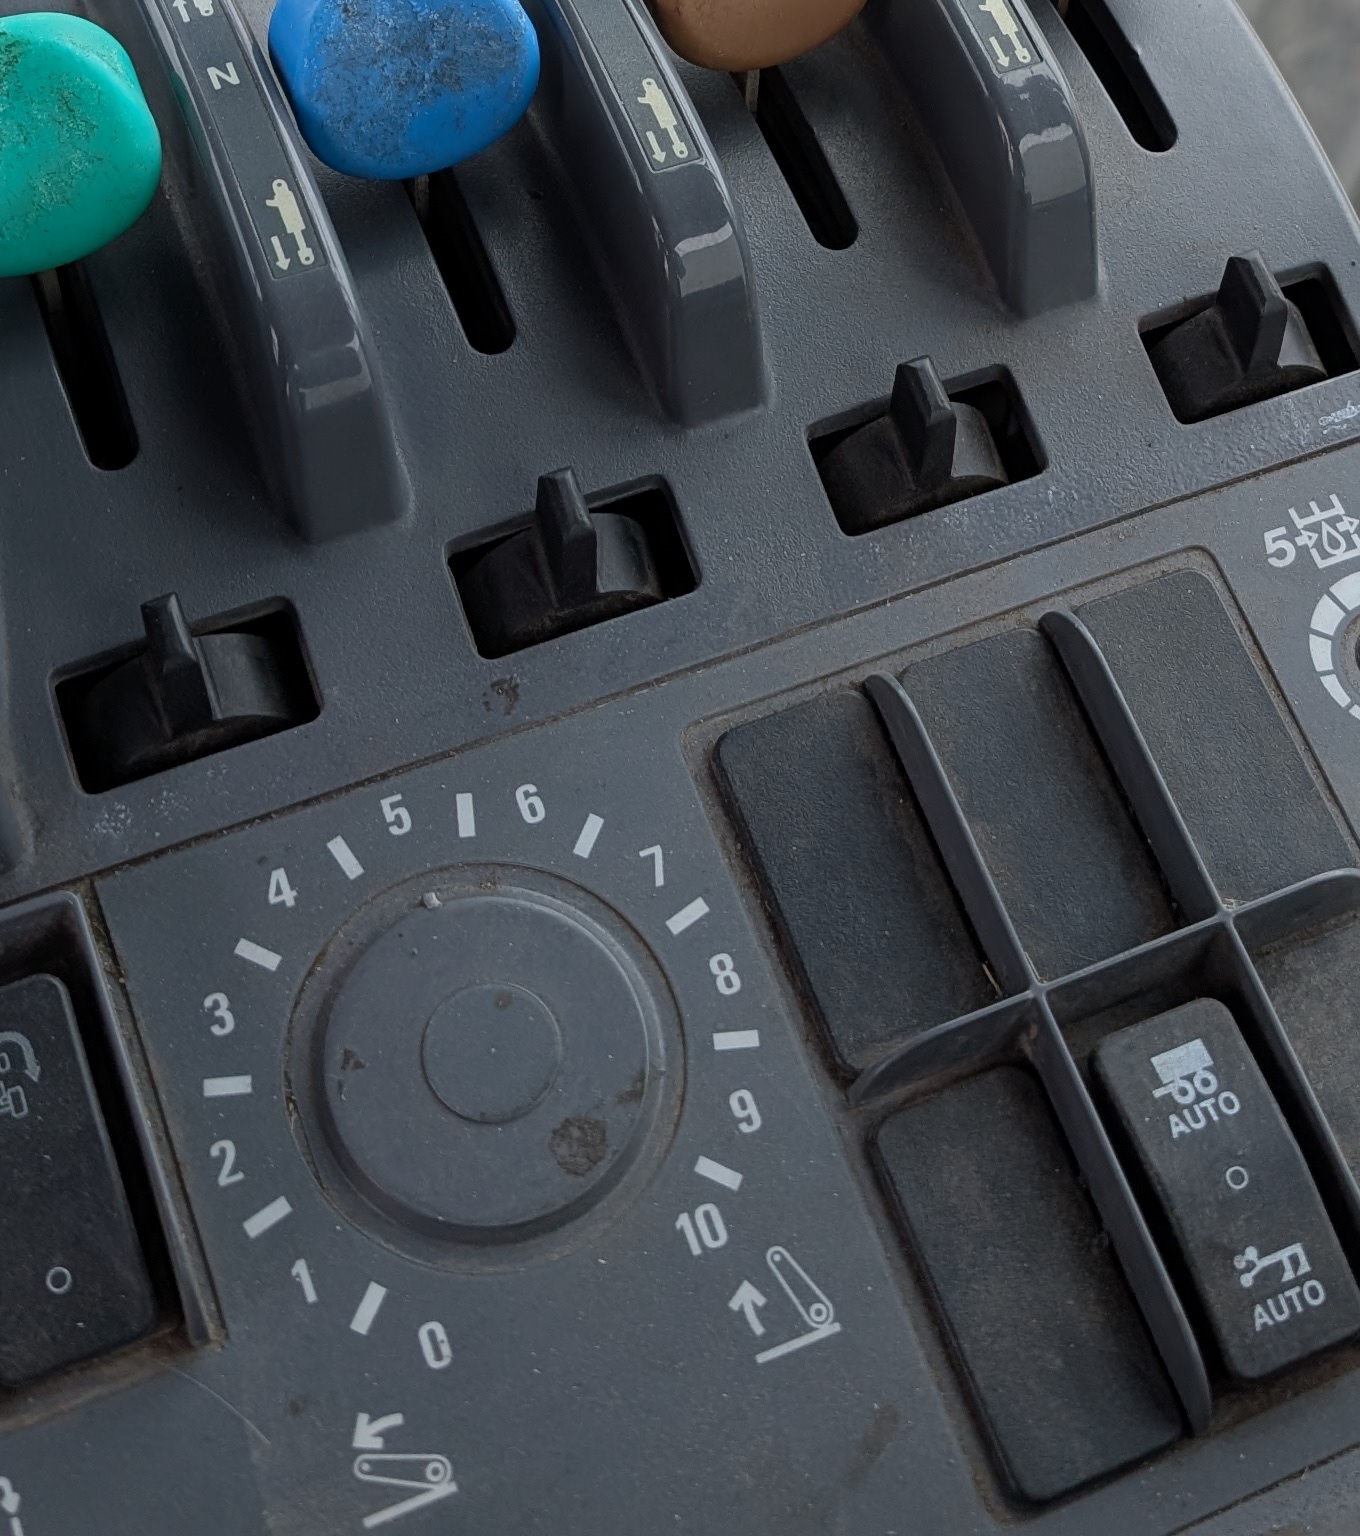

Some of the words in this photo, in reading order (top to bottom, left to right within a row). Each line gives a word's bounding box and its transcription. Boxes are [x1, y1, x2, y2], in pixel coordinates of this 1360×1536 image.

[206, 61, 241, 90] N
[1263, 526, 1297, 568] 5
[380, 793, 412, 836] 5
[515, 783, 546, 824] 6
[268, 867, 298, 908] 4
[638, 844, 665, 887] 7
[709, 952, 742, 996] 8
[203, 992, 235, 1036] 3
[729, 1089, 762, 1134] 9
[1167, 1090, 1241, 1139] AUTO
[209, 1139, 245, 1187] 2
[675, 1203, 728, 1256] 10
[291, 1258, 318, 1304] 1
[1252, 1278, 1326, 1332] AUTO
[418, 1321, 452, 1370] 0
